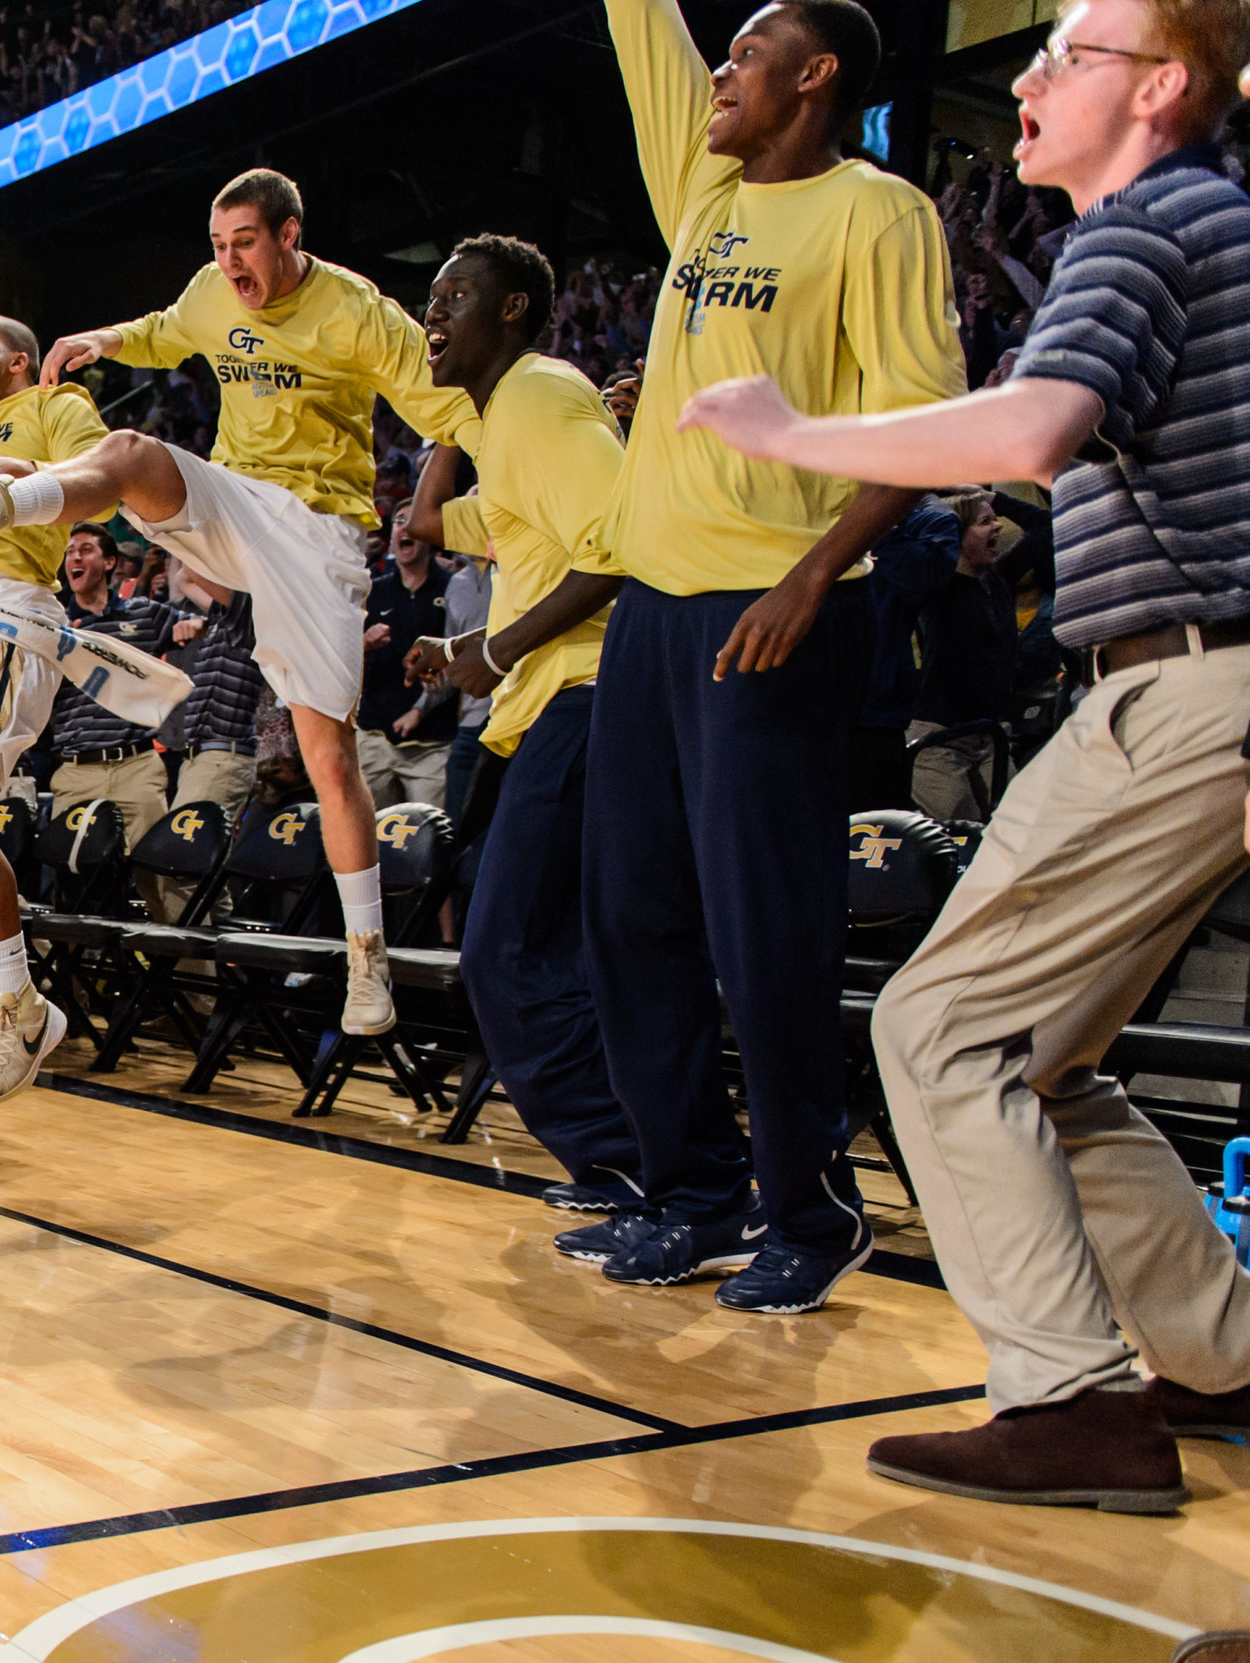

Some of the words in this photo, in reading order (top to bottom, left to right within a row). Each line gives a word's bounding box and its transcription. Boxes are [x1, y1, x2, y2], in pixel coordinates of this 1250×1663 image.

[672, 263, 779, 314] SRM
[743, 266, 782, 282] WE
[228, 327, 265, 354] GT
[215, 354, 269, 372] TOGER
[274, 362, 298, 373] WE
[171, 810, 205, 840] GT
[268, 813, 306, 845] GT
[376, 814, 420, 849] GT
[849, 824, 903, 868] GT
